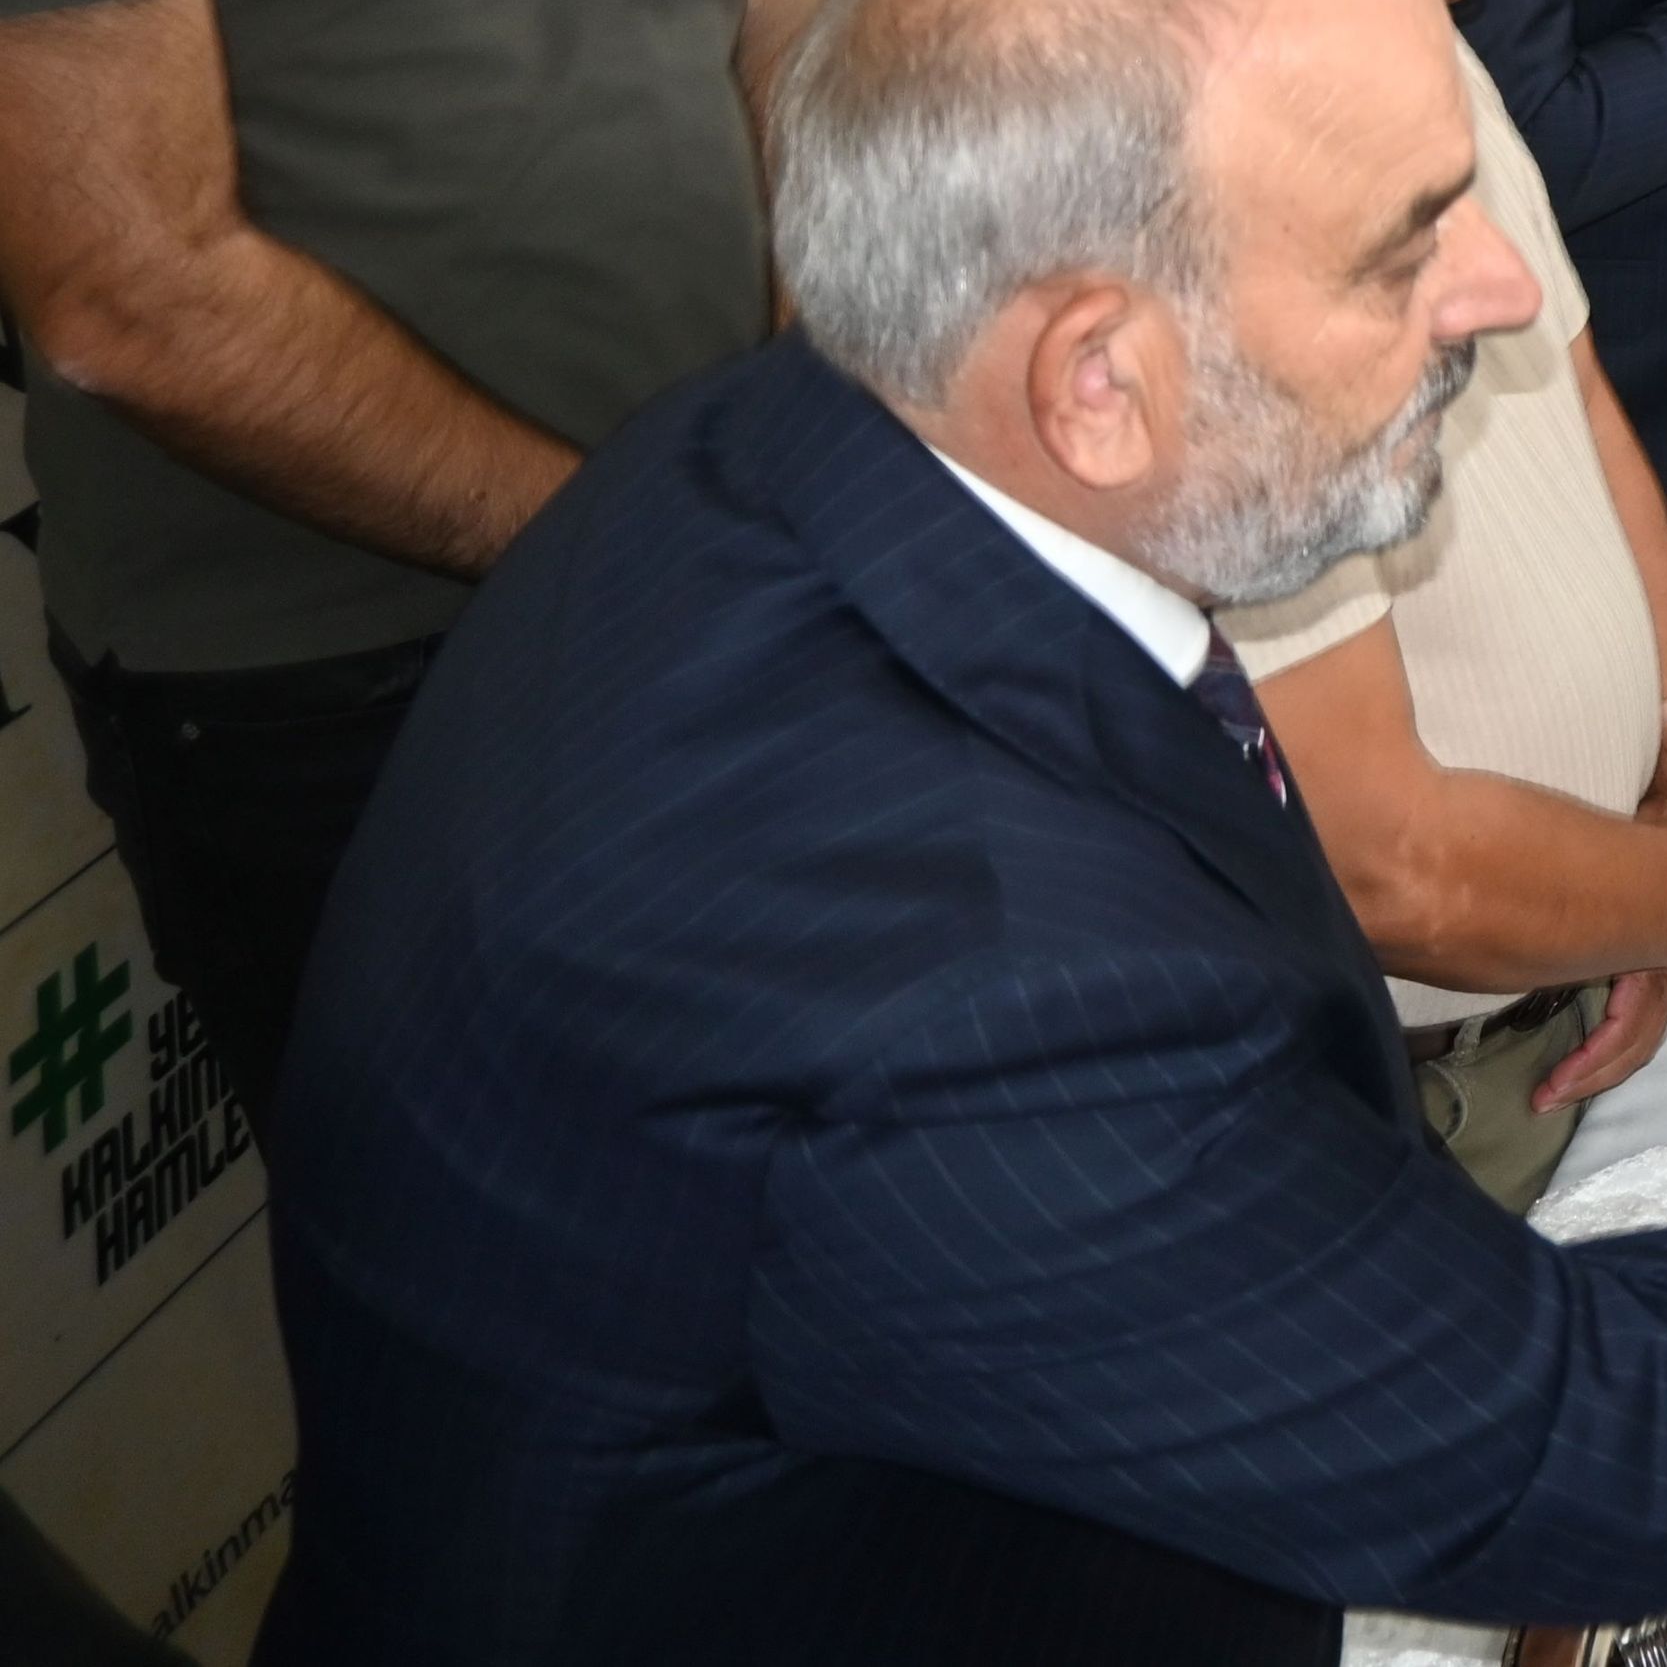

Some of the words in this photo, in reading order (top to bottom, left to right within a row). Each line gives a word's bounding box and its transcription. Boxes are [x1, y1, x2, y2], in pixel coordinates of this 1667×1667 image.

[61, 1042, 232, 1240] KALKIN
[96, 1094, 251, 1288] HAMLE
[151, 1467, 300, 1641] alkinma
